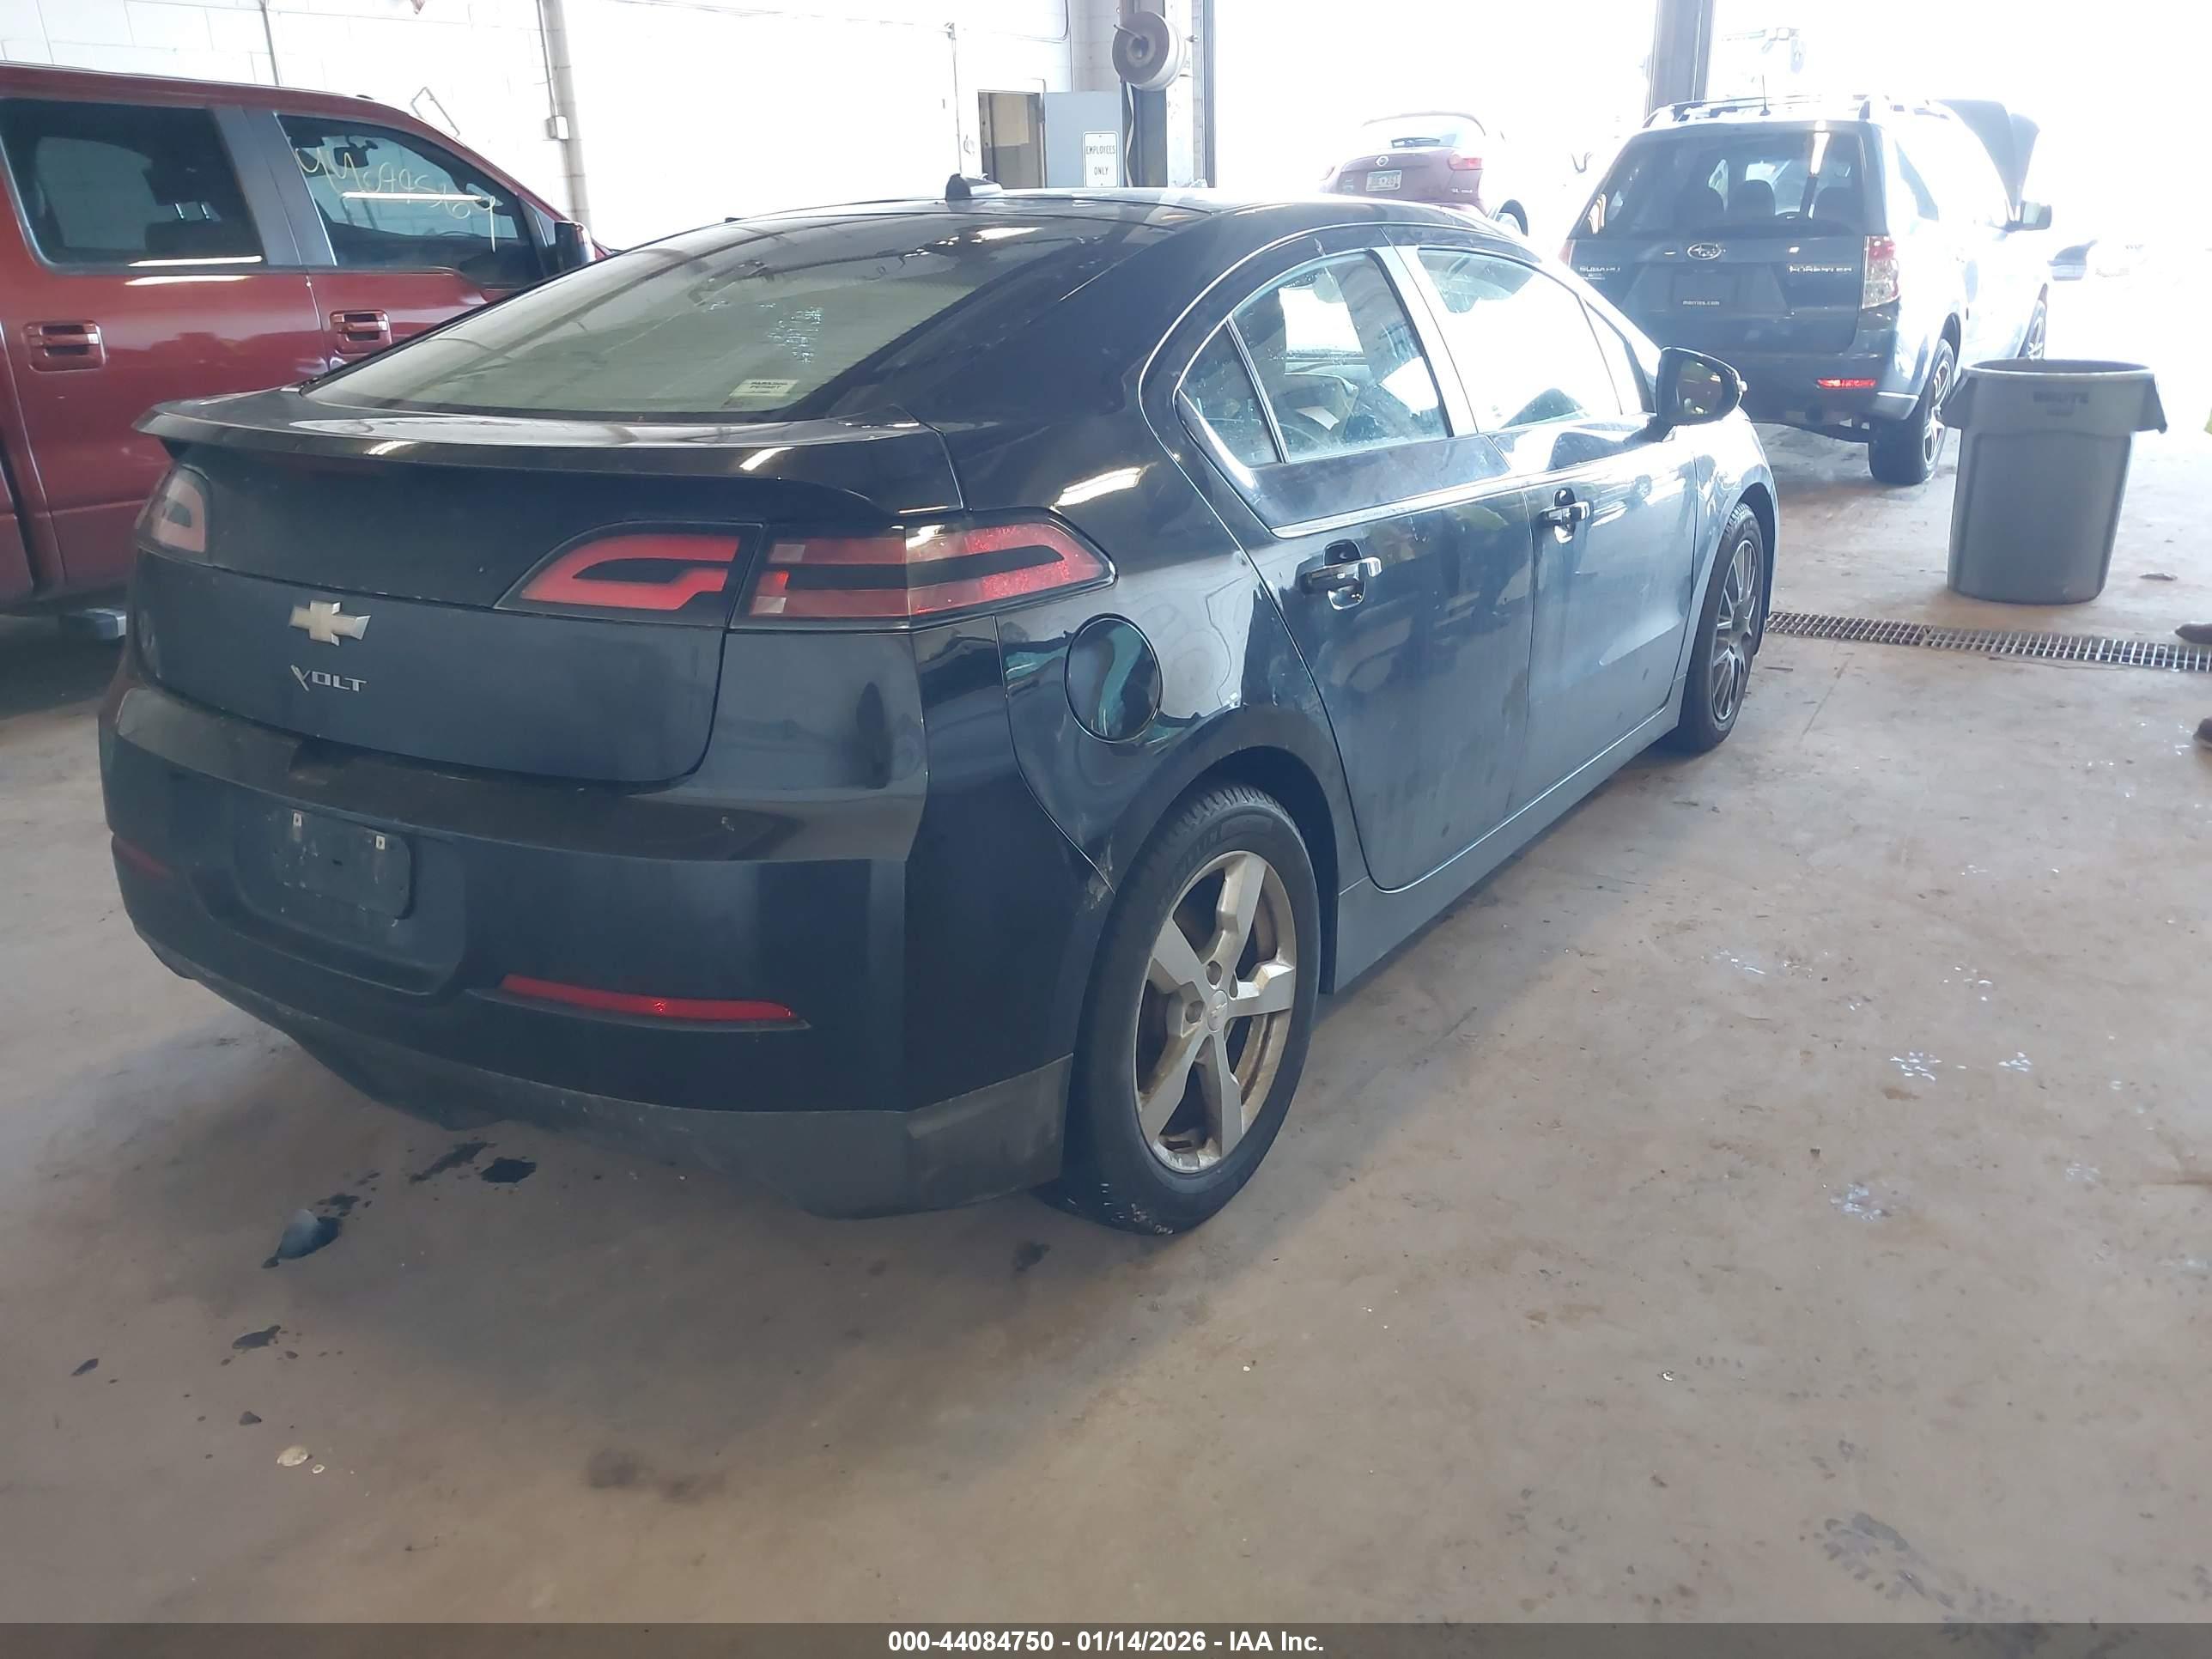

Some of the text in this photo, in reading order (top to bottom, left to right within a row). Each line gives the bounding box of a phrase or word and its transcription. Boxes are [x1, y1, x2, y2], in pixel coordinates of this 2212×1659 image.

[1085, 144, 1116, 155] EMPLOYEES
[1093, 166, 1109, 176] ONLY
[290, 665, 368, 692] VOLT
